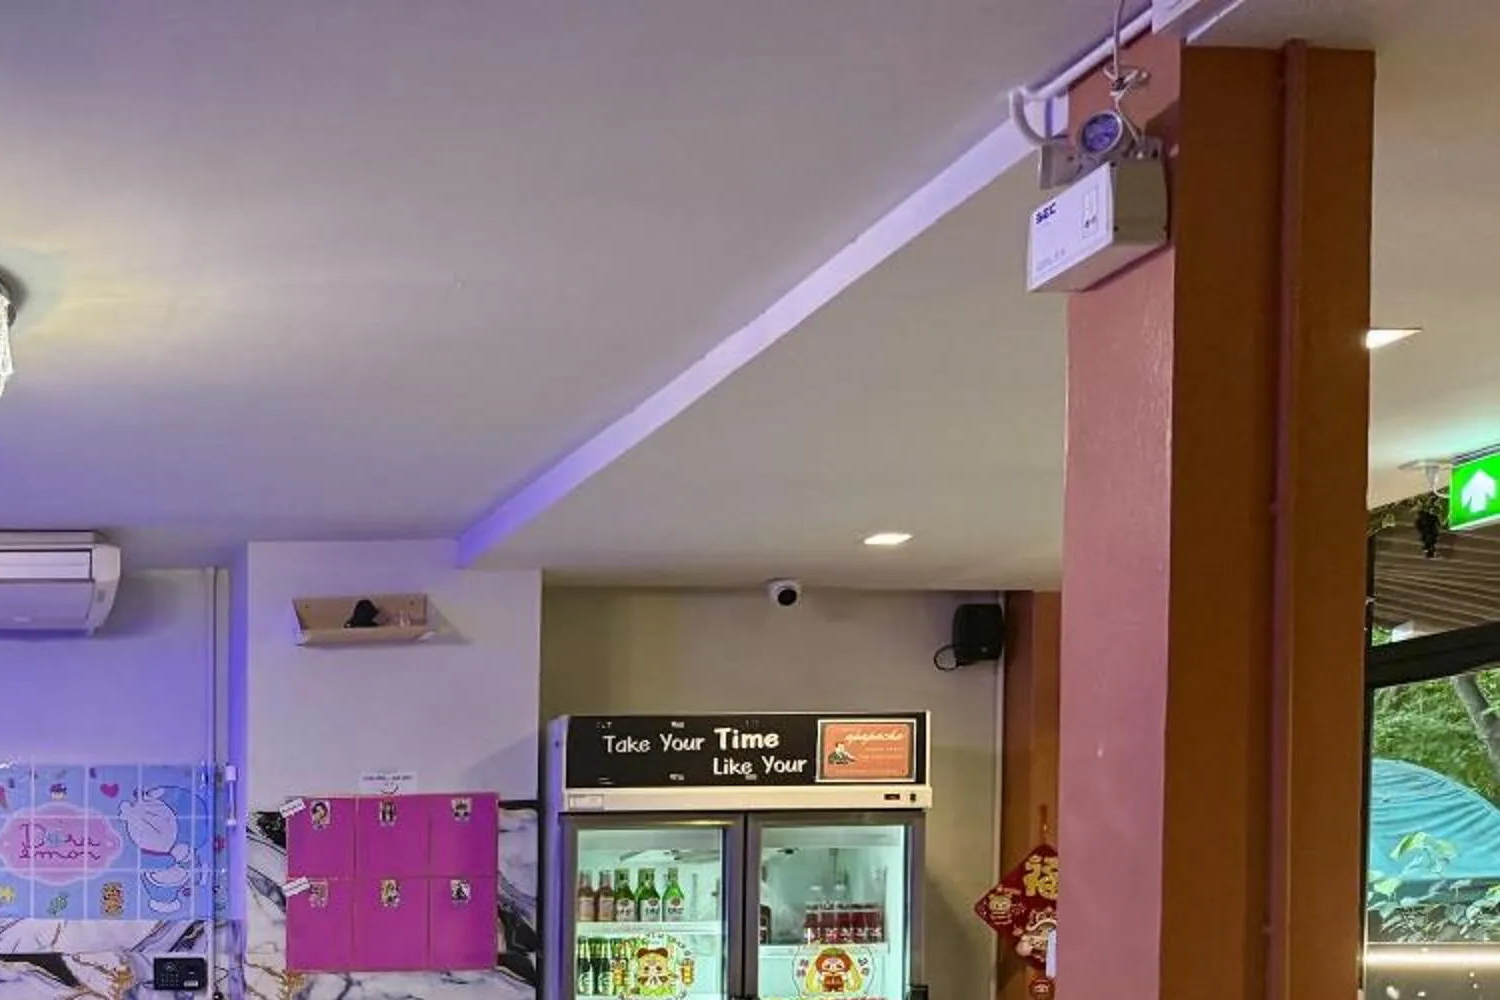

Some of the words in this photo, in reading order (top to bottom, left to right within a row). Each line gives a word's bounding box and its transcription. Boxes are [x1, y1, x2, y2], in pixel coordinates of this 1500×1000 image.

[602, 735, 651, 753] Take
[659, 733, 706, 752] Your
[713, 727, 779, 750] Time
[713, 756, 753, 775] Like
[761, 755, 808, 774] Your
